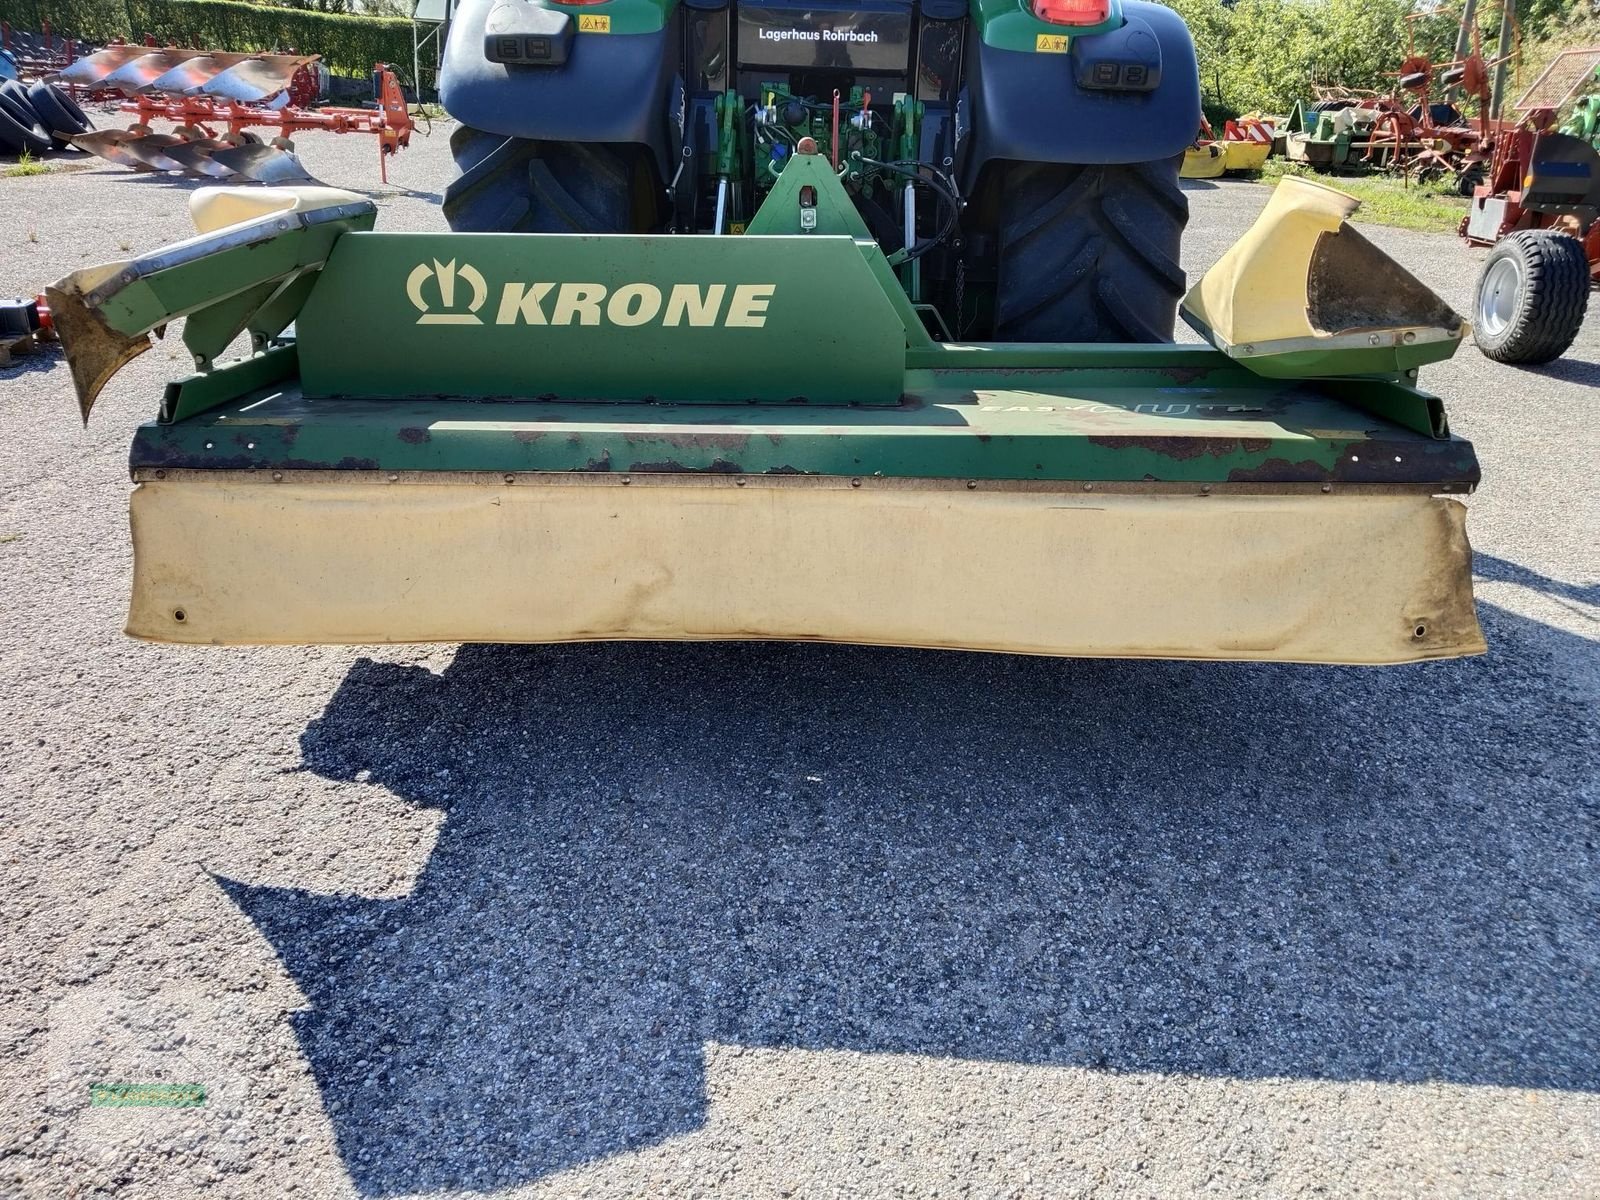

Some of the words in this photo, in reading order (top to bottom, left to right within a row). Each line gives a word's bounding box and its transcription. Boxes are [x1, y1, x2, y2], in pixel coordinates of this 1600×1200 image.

[759, 28, 820, 42] Lagerhaus
[822, 30, 878, 42] Rohrbach
[495, 282, 777, 328] KRONE
